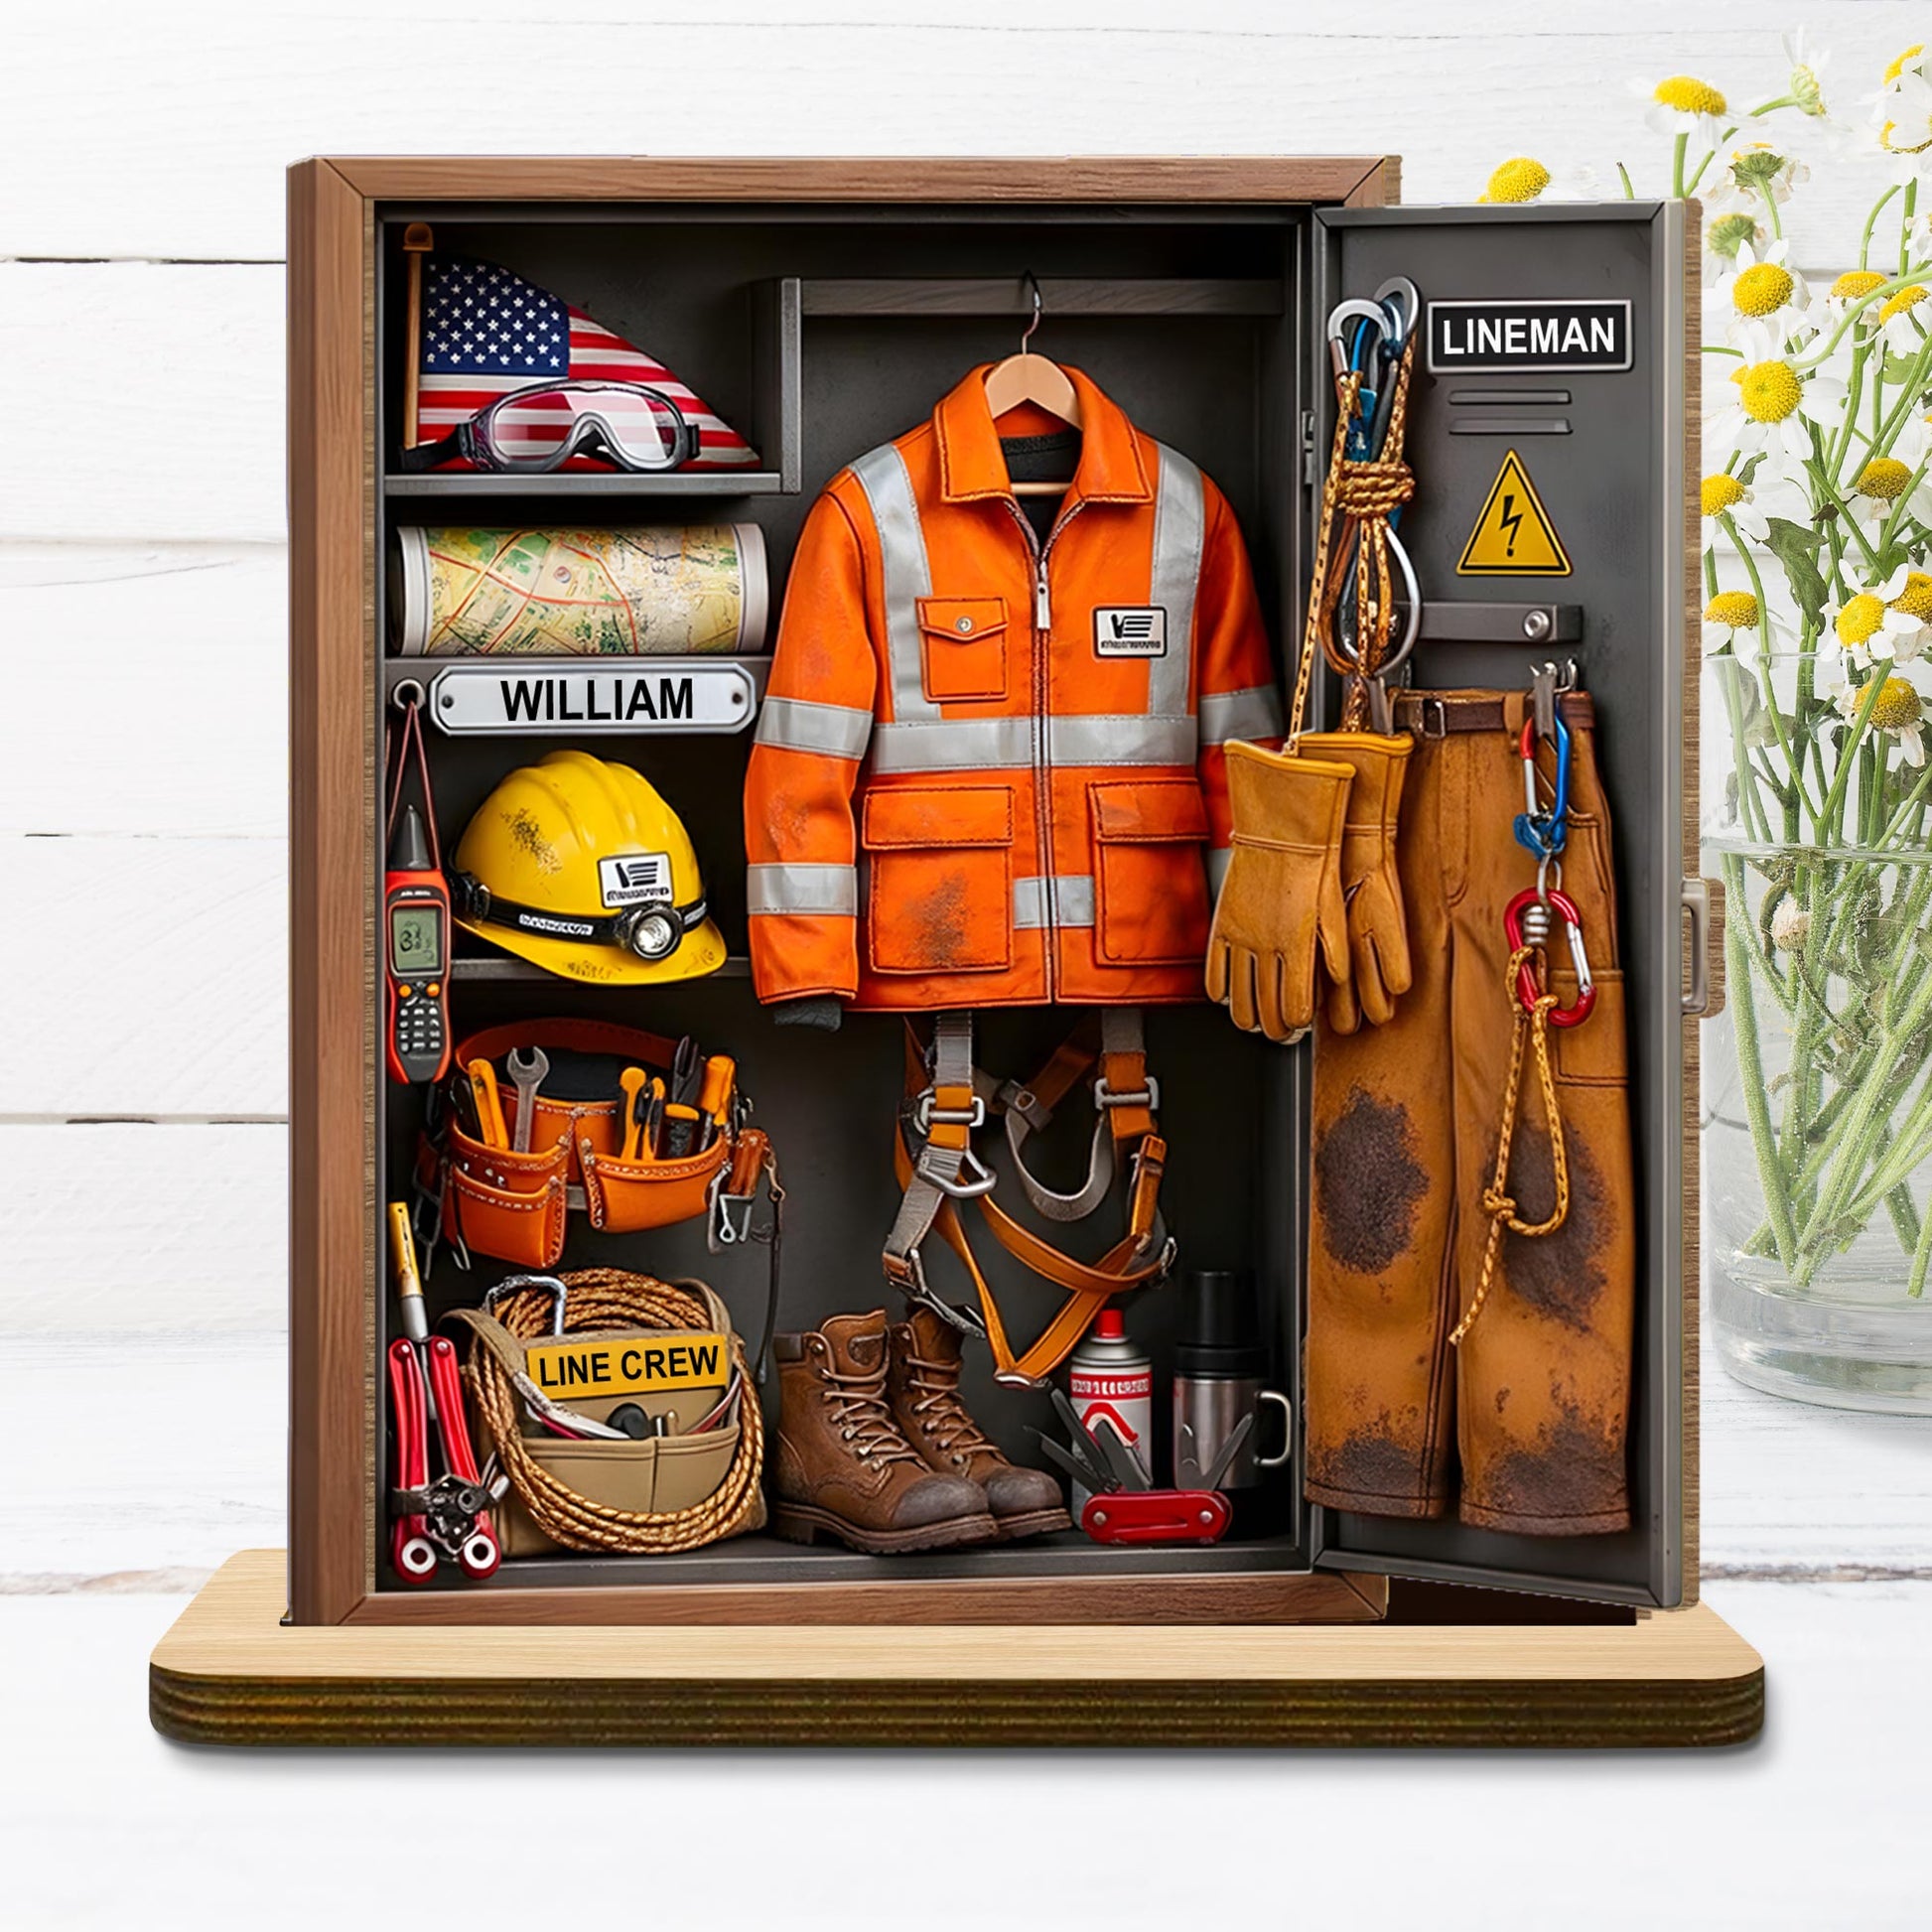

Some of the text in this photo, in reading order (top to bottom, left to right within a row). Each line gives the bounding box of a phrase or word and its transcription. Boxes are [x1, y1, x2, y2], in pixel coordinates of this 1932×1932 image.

[1444, 318, 1614, 354] LINEMAN
[500, 678, 693, 721] WILLIAM
[539, 1345, 719, 1387] LINE CREW
